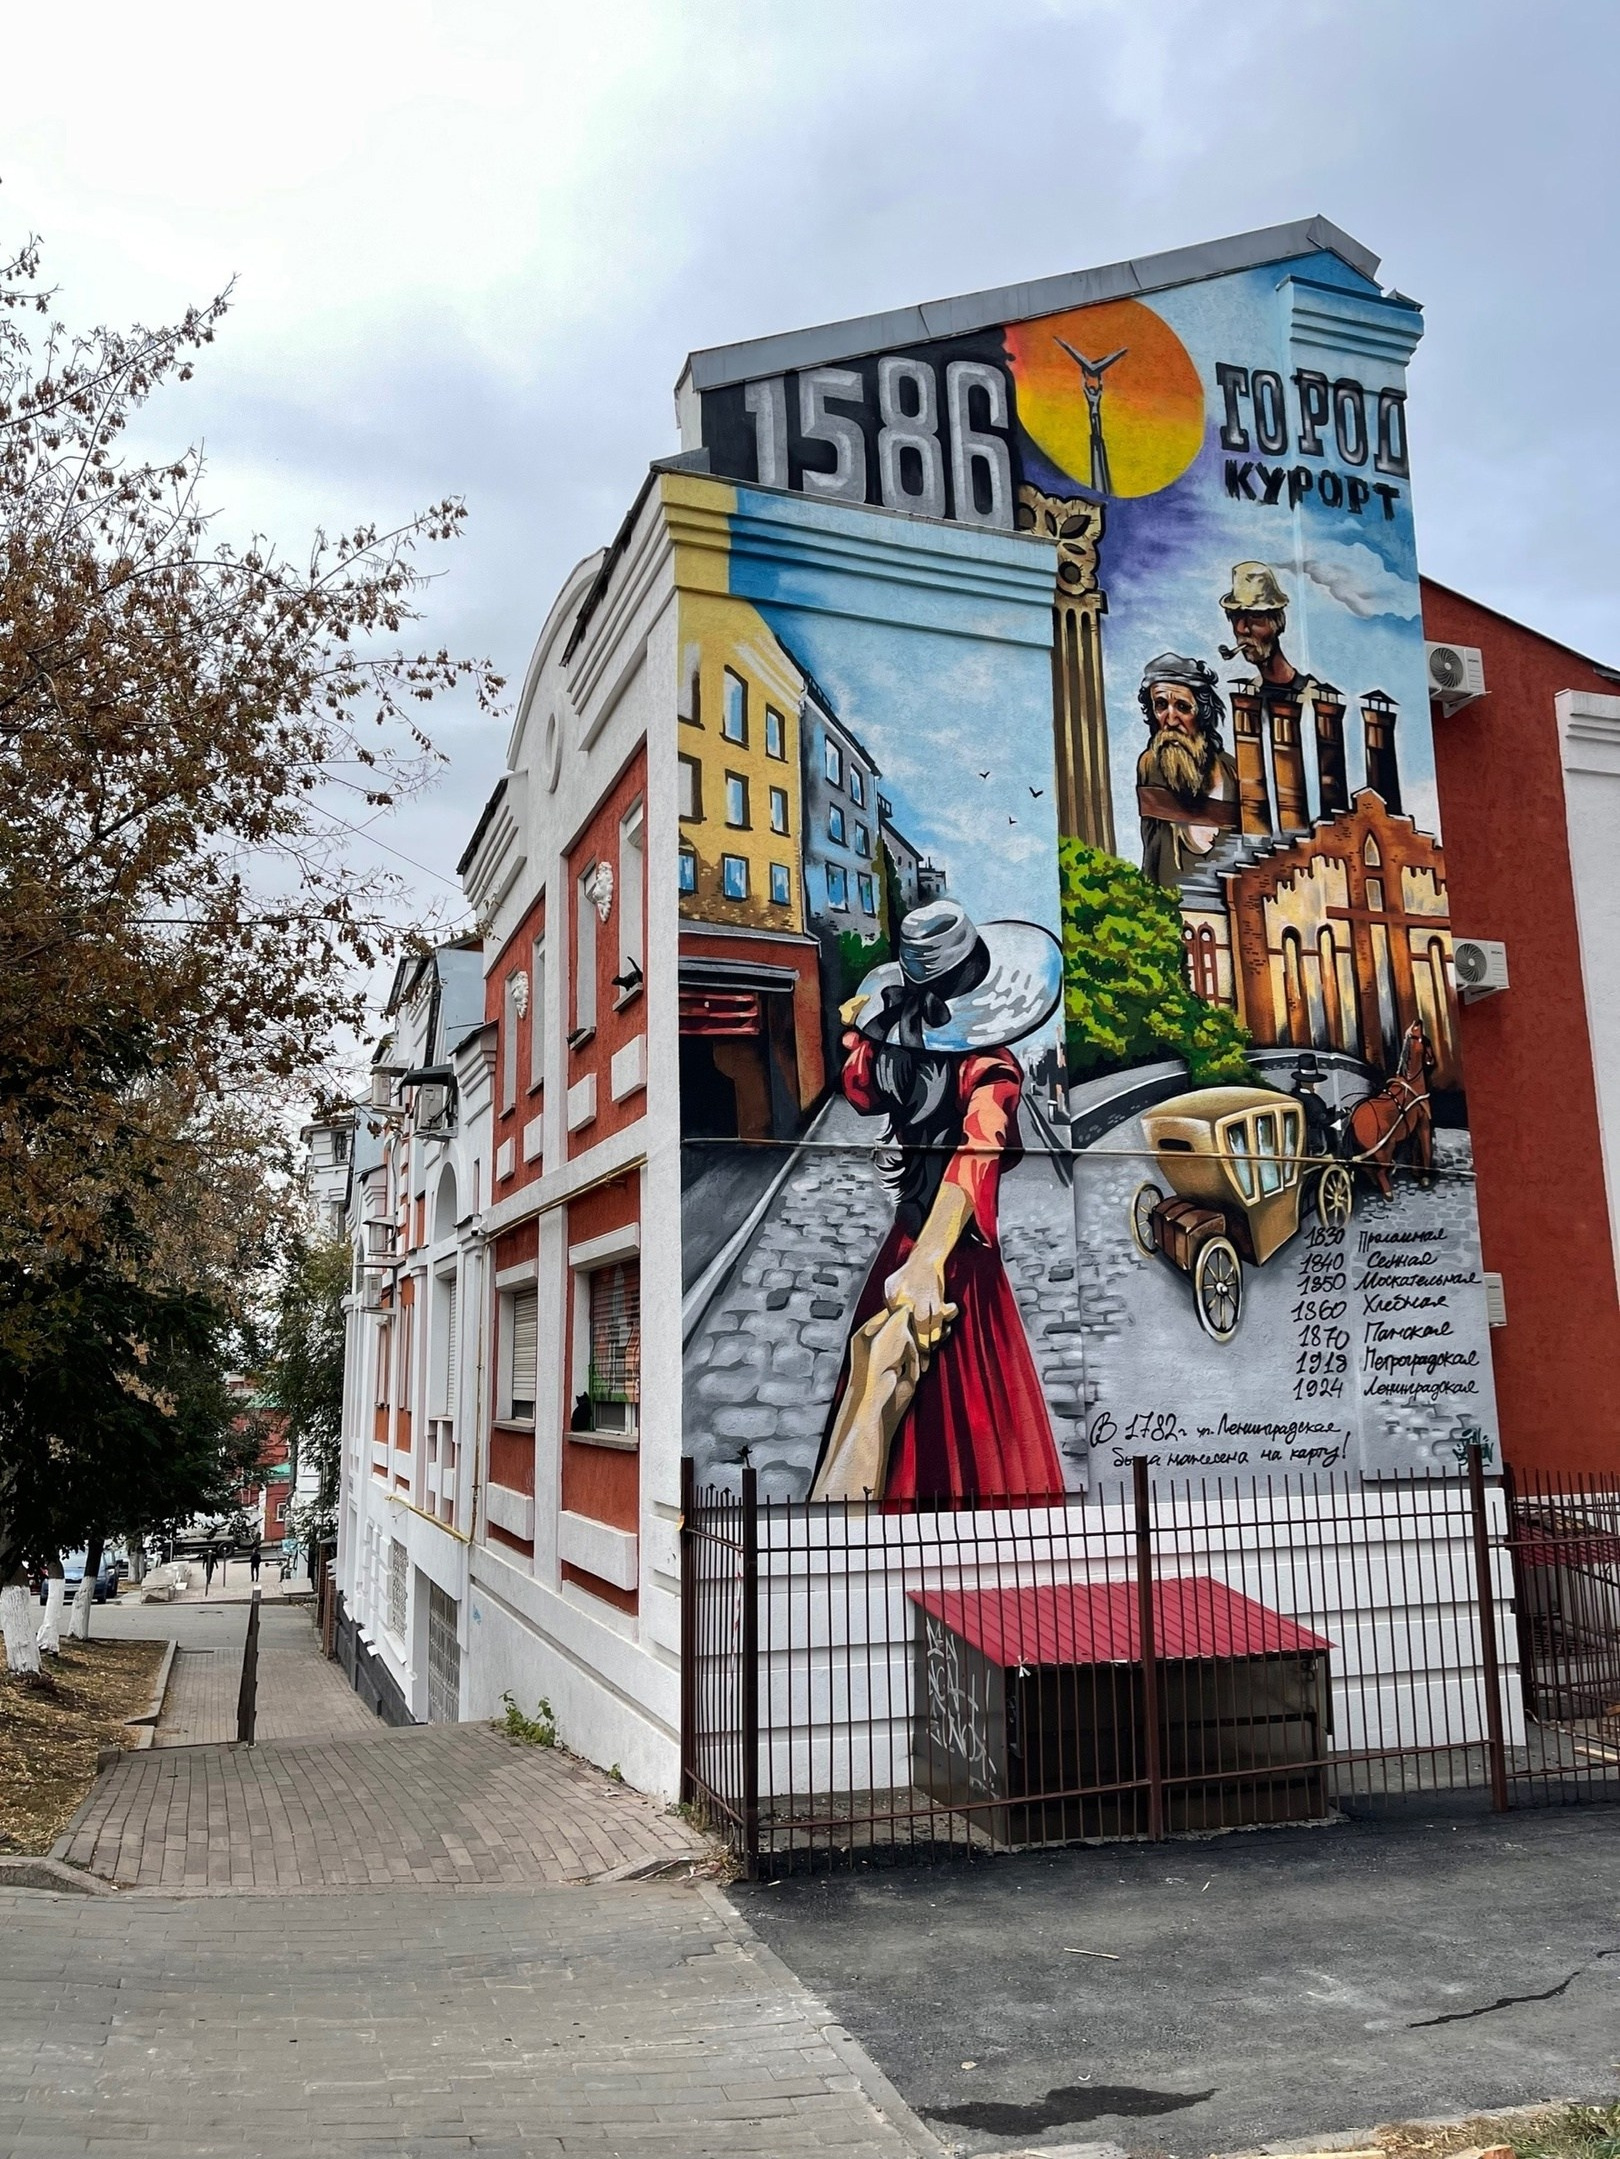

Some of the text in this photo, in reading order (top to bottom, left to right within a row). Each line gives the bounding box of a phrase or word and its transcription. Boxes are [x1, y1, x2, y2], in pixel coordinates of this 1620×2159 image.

[1216, 362, 1410, 480] ГОРОД
[745, 356, 1018, 530] 1586
[1225, 459, 1400, 522] КУРОРТ
[1303, 1225, 1346, 1249] 1830
[1298, 1251, 1439, 1275] 1840 Сенная
[1297, 1270, 1482, 1296] 1850 Москательная
[1290, 1294, 1450, 1323] 1860 Хлебная
[1298, 1321, 1454, 1351] 1870 Панская
[1296, 1345, 1480, 1377] 1918 Петроградская
[1292, 1375, 1480, 1401] 1924 Ленинградская
[1090, 1411, 1118, 1448] В
[1217, 1412, 1342, 1445] Ленинградская
[1166, 1452, 1249, 1466] нанесена
[1260, 1448, 1282, 1461] на
